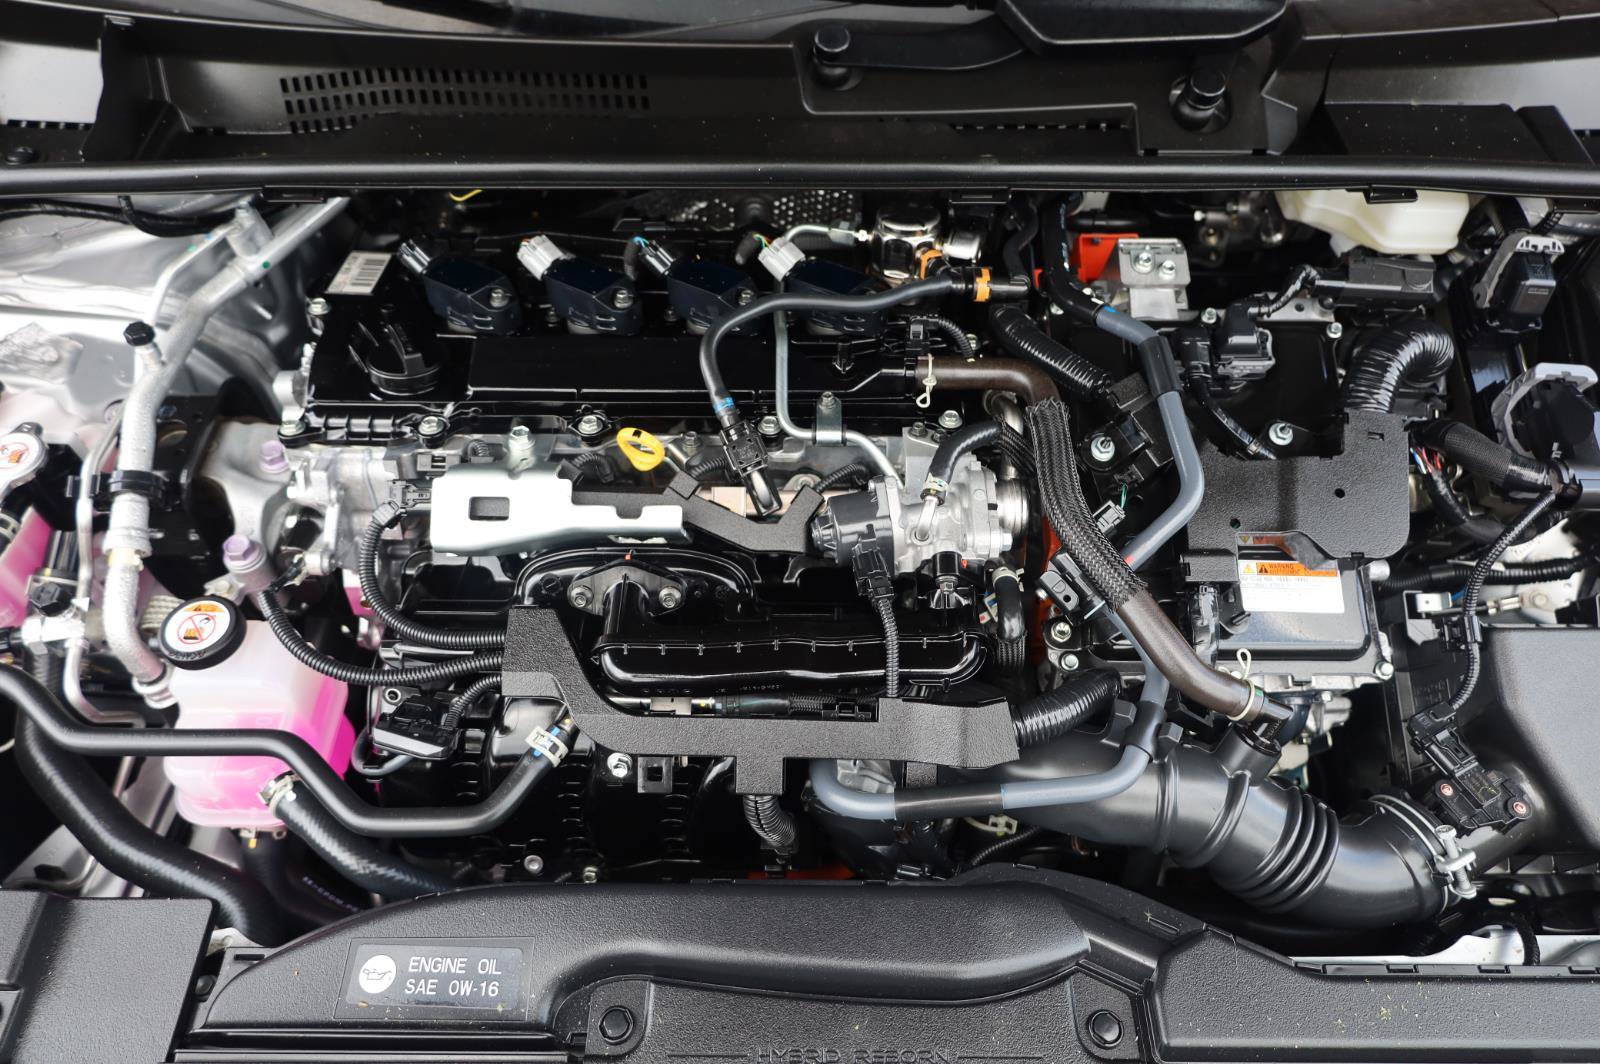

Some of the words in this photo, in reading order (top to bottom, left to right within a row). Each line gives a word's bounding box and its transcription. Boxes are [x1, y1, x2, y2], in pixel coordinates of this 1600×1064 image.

[408, 956, 467, 974] ENGINE
[478, 958, 502, 975] OIL
[404, 978, 438, 995] SAE
[448, 980, 500, 997] 0W-16
[758, 1047, 840, 1064] HYBRID
[853, 1048, 948, 1064] REBORN
